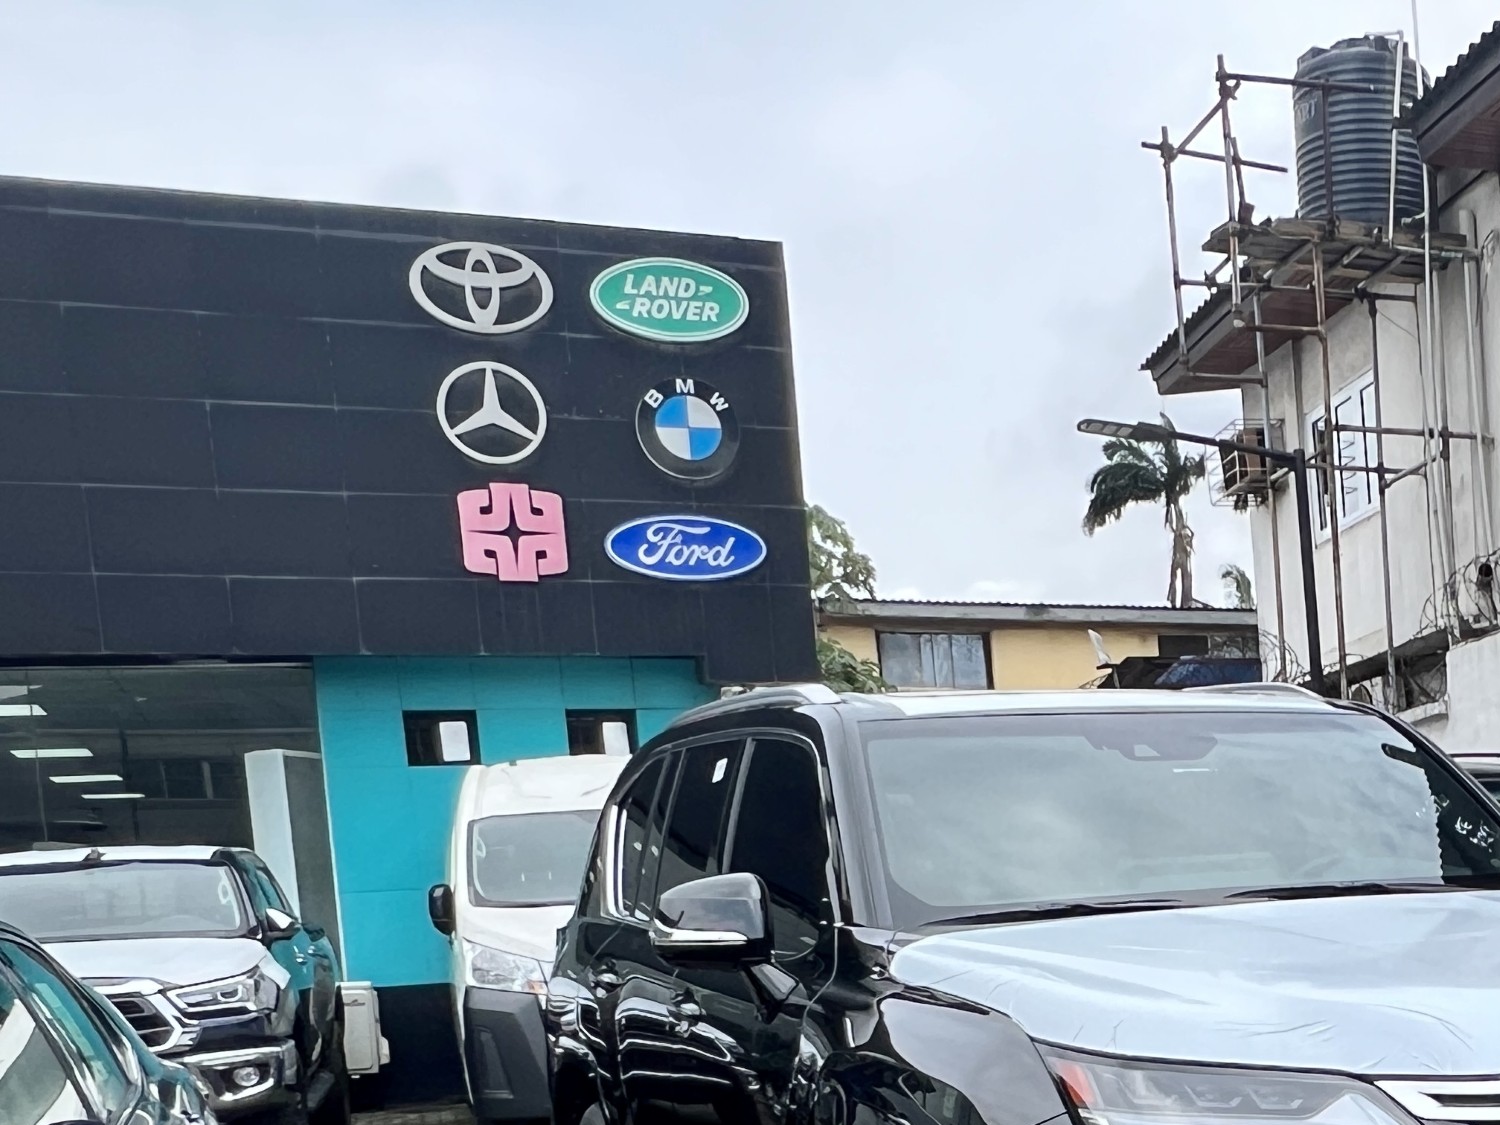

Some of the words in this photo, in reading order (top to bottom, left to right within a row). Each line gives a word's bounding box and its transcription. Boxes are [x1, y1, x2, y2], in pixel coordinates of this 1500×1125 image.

[632, 297, 720, 322] ROVER
[644, 378, 729, 411] BMW
[637, 522, 736, 566] Ford
